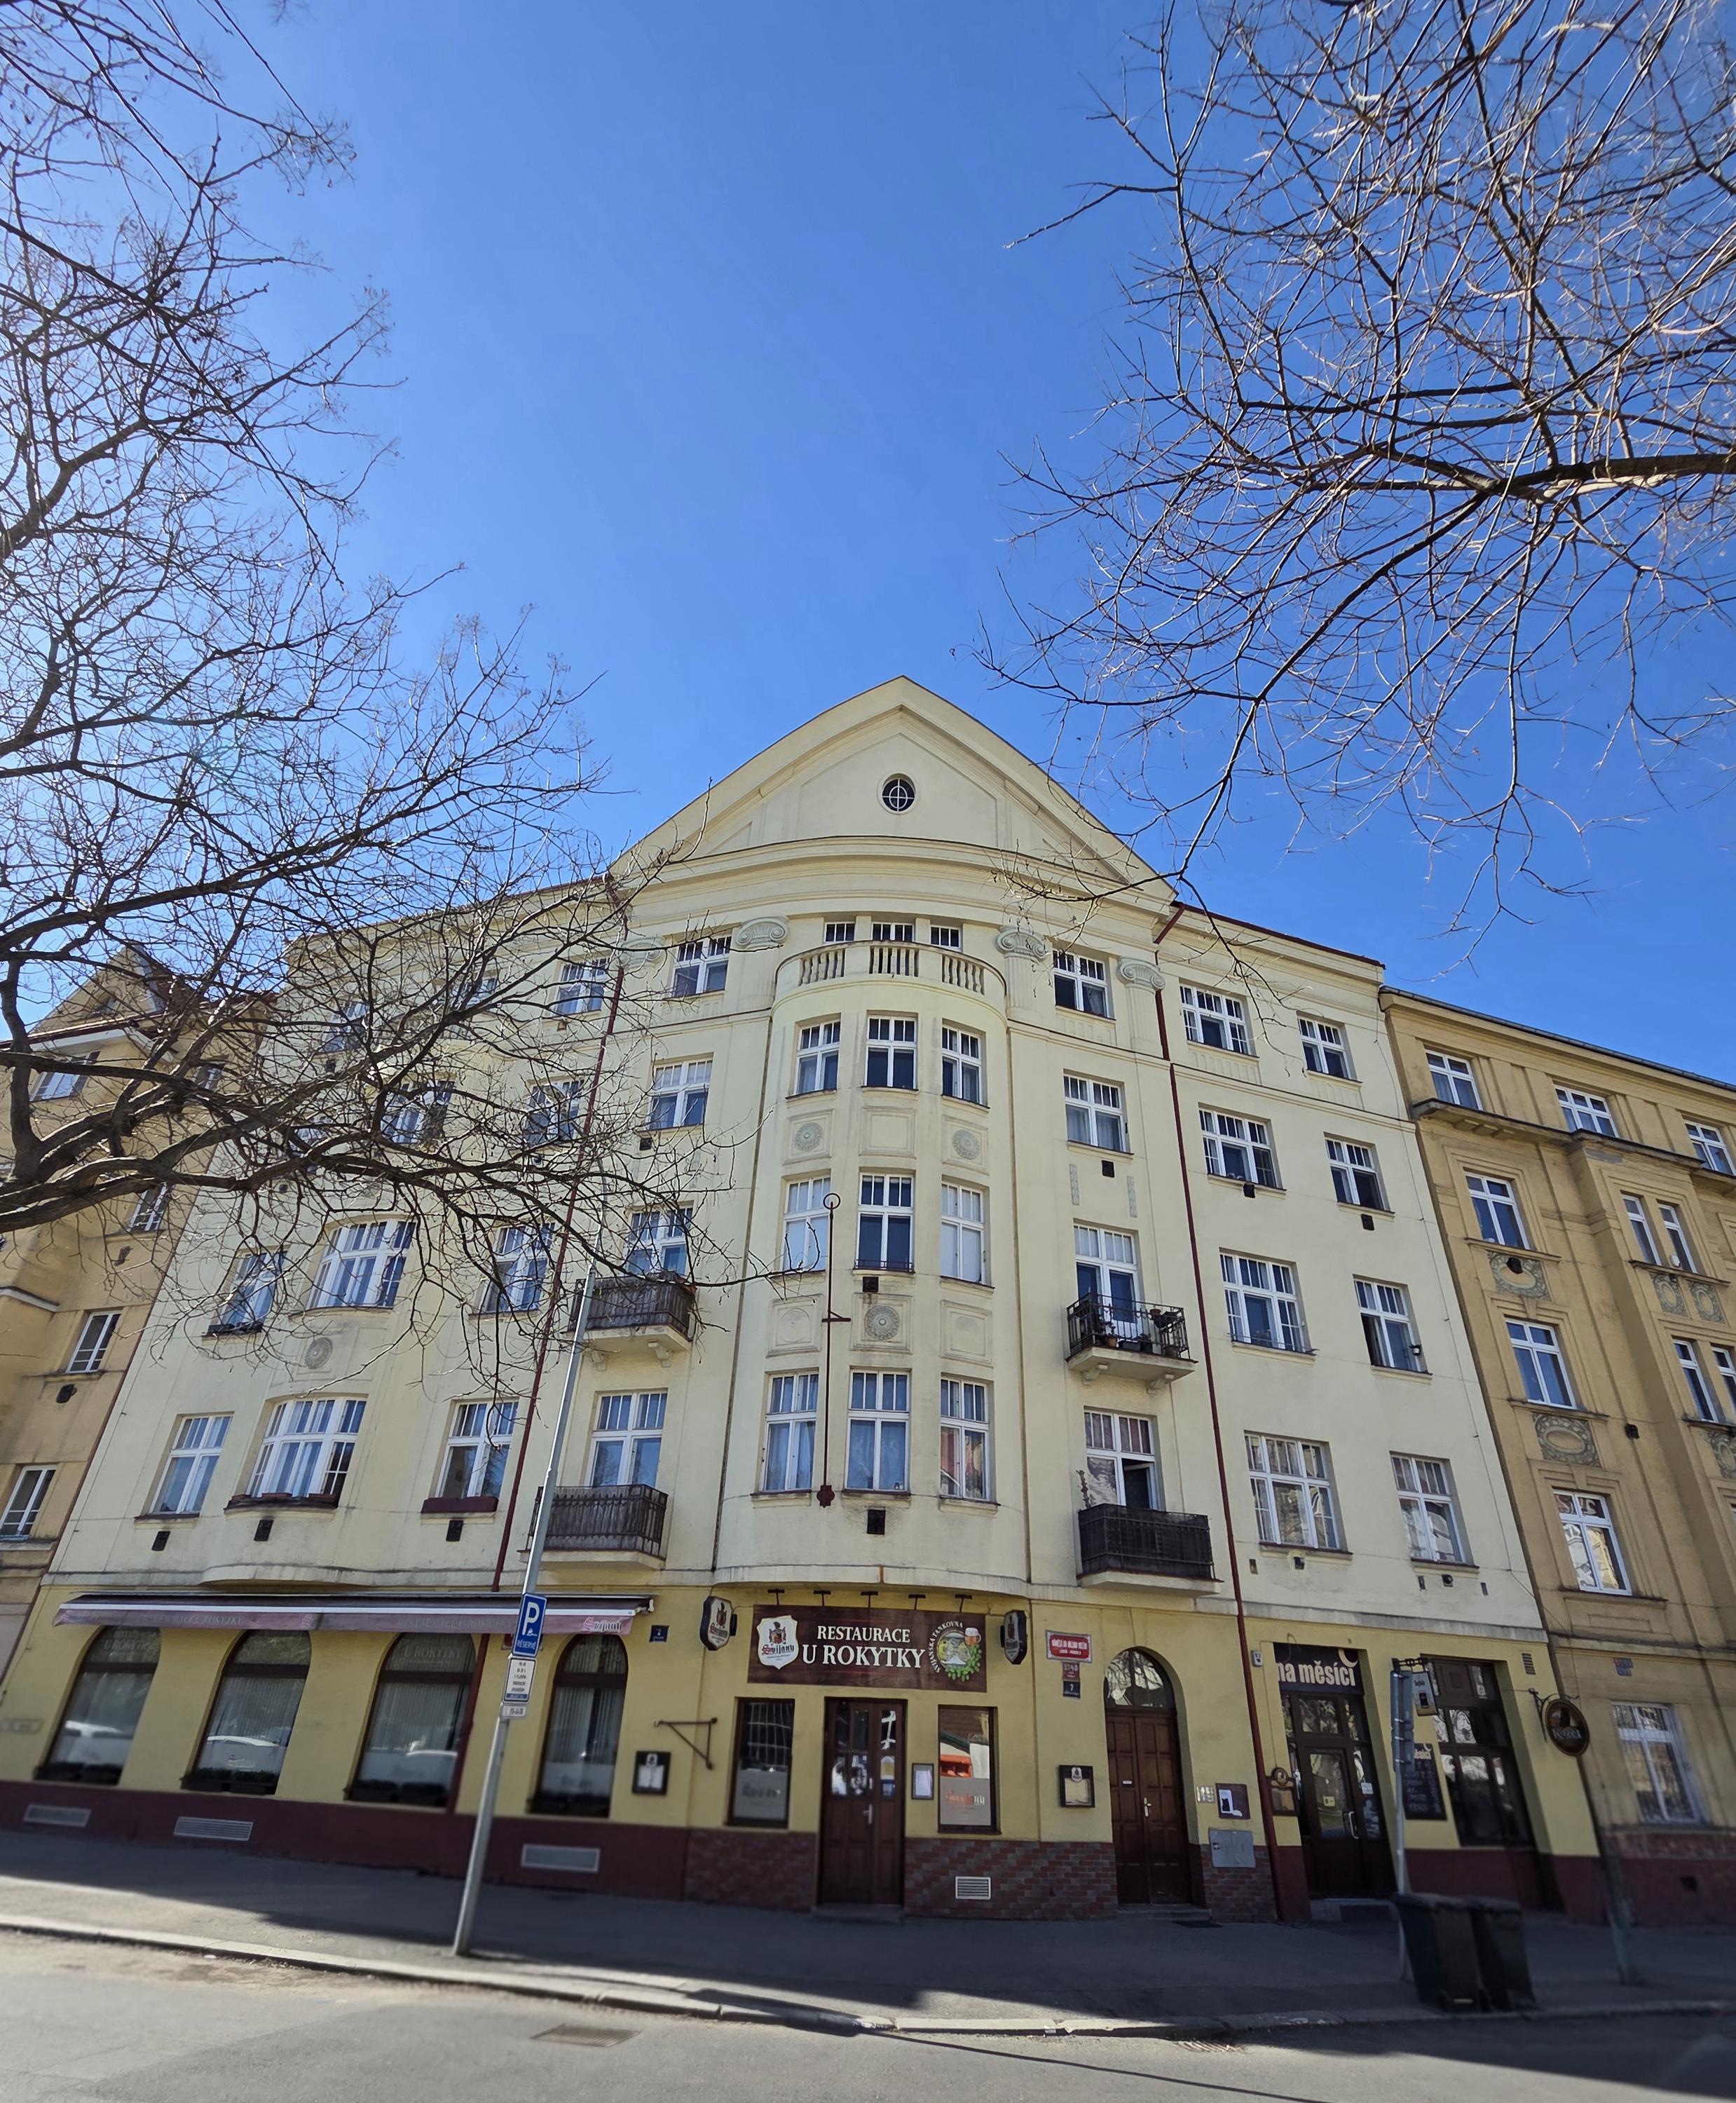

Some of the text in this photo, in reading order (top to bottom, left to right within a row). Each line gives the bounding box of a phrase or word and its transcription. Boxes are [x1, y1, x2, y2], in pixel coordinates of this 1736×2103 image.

[522, 1601, 540, 1635] P
[817, 1626, 910, 1642] RESTAURACE
[932, 1621, 963, 1638] TANKOVNA
[762, 1645, 794, 1655] Svijany
[802, 1645, 925, 1668] U ROKYTKY
[1276, 1660, 1355, 1686] na měsíci
